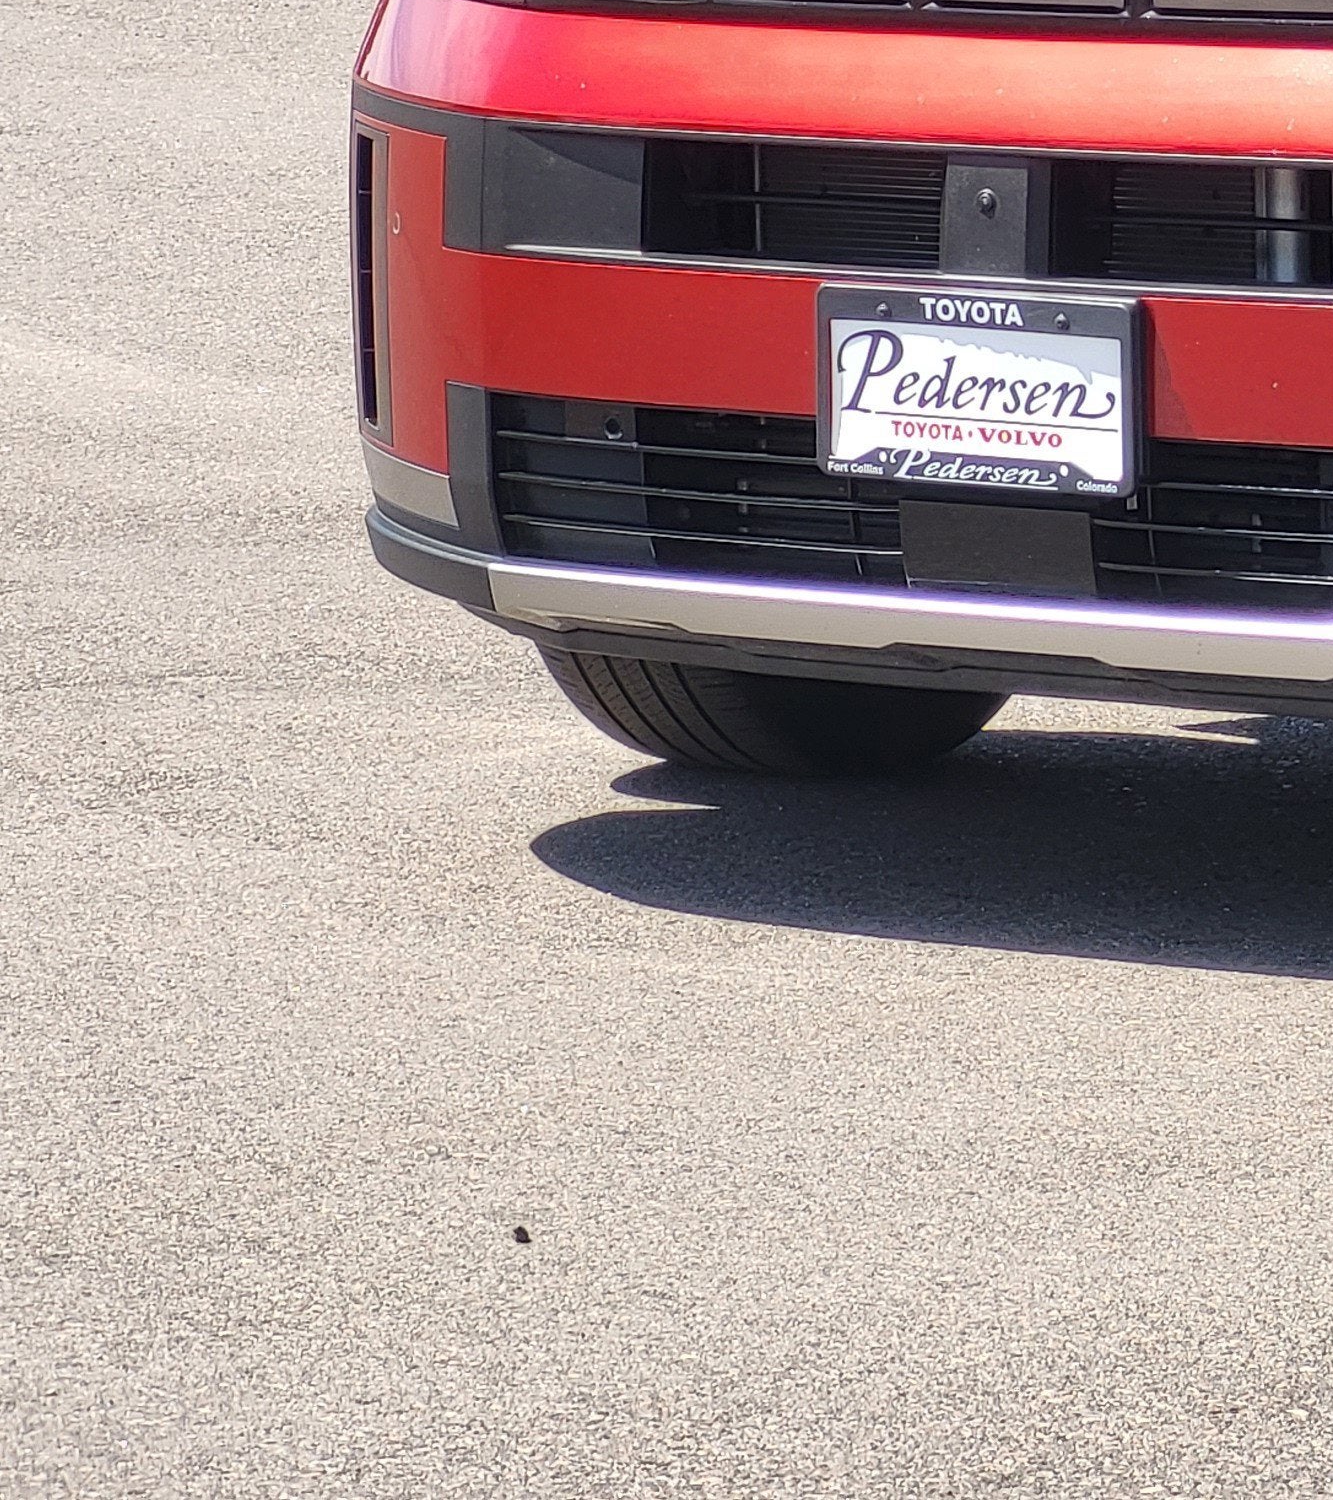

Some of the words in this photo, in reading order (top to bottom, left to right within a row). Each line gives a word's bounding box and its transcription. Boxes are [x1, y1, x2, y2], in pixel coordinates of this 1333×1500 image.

[918, 296, 1024, 326] TOYOTA
[837, 329, 1116, 420] Pedersen
[891, 420, 963, 442] TOYOTA
[978, 426, 1063, 448] VOLVO
[827, 461, 849, 473] Fort
[850, 462, 884, 475] Collins
[889, 448, 1058, 485] Pedersen
[1075, 479, 1119, 494] Colorado
